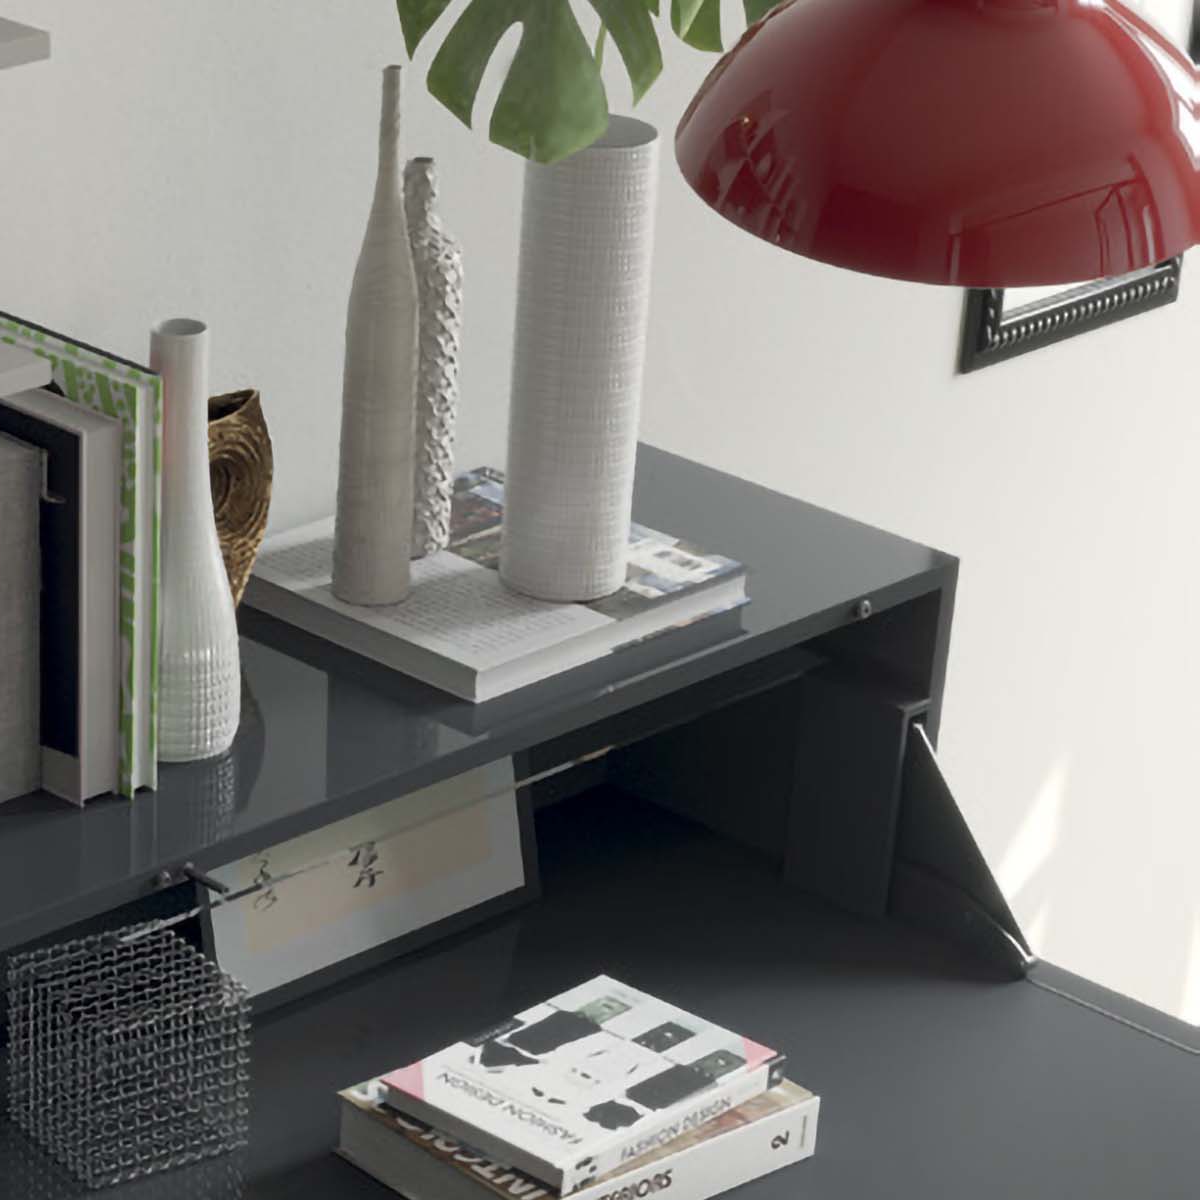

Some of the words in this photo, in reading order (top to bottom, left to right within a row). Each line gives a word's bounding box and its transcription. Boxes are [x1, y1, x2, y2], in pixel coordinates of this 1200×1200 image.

[435, 1072, 502, 1107] DESIGN
[502, 1105, 584, 1145] FASHION
[620, 1121, 680, 1160] FASHION
[770, 1130, 790, 1150] 2
